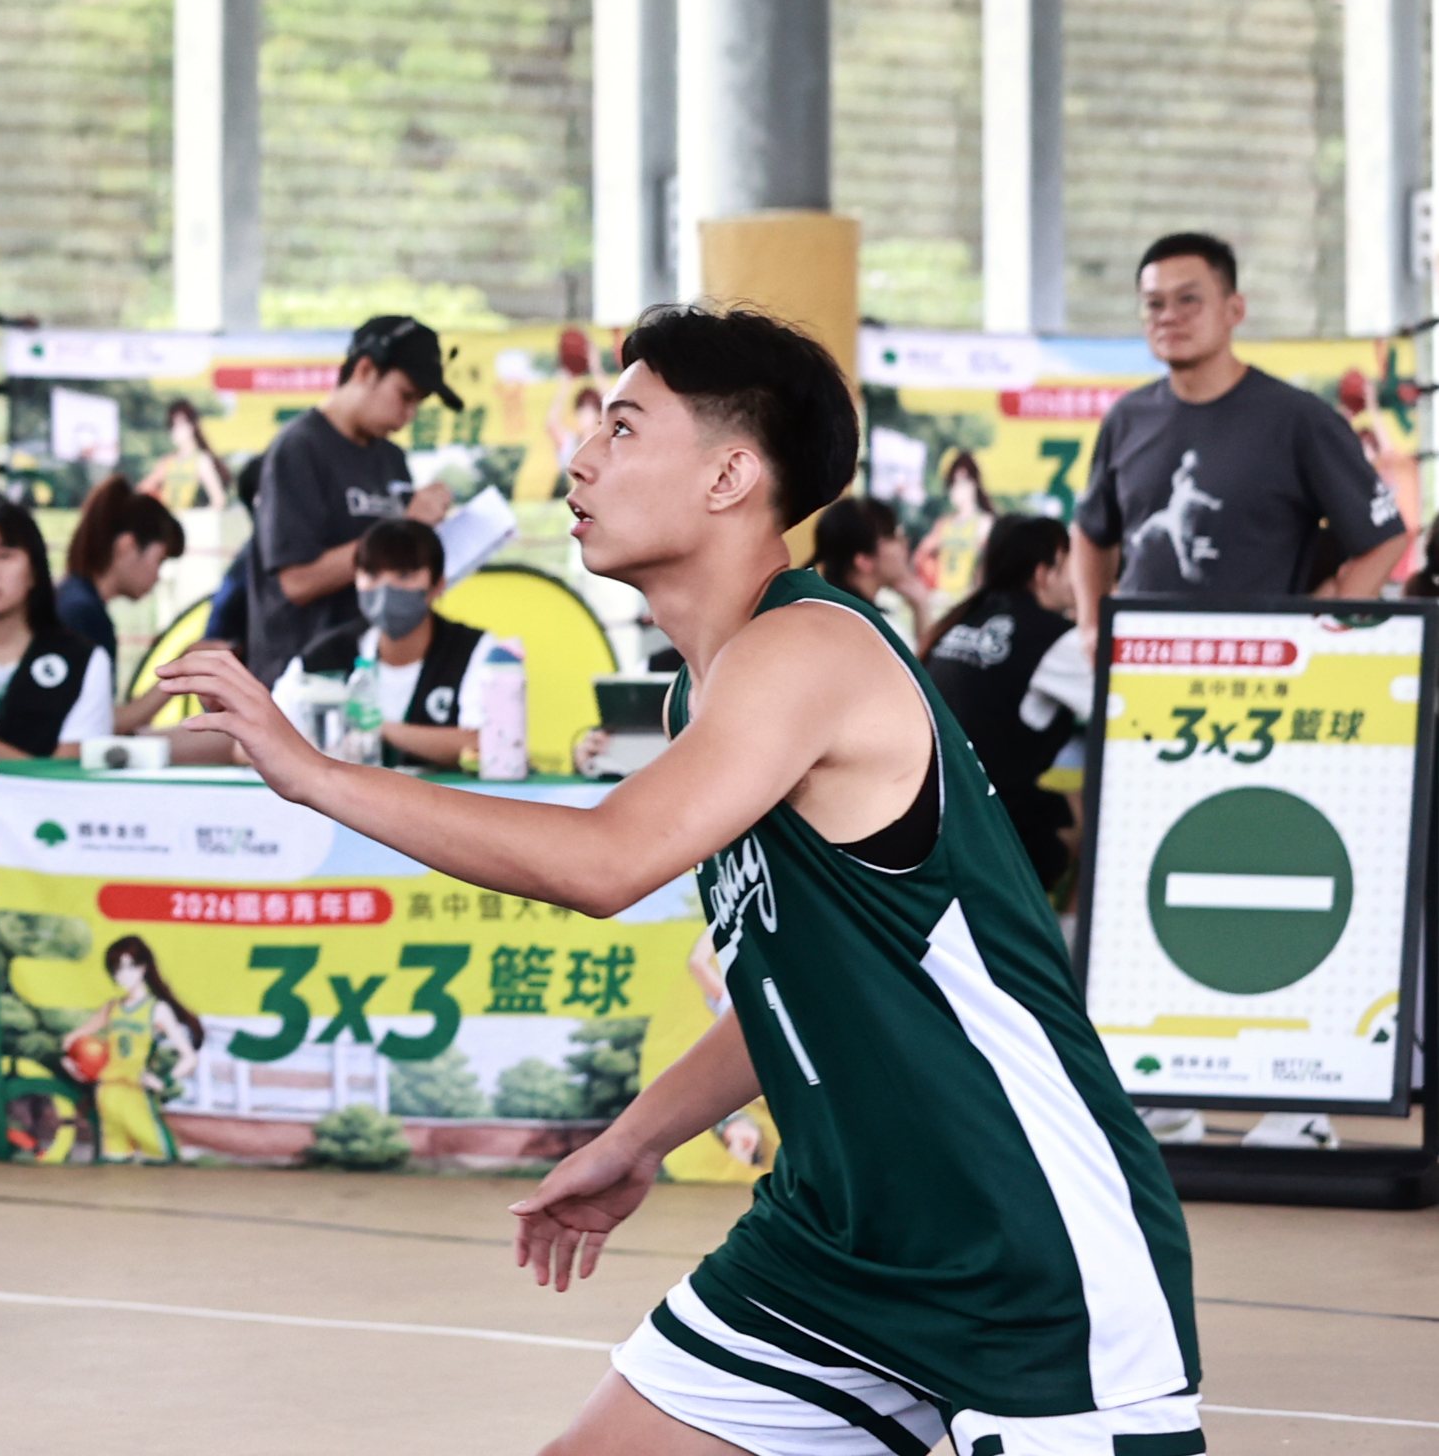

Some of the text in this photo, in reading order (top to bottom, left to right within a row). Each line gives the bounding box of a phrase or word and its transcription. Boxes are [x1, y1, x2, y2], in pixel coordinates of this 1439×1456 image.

[1157, 706, 1366, 764] 3x3 籃球
[170, 890, 376, 923] 2026國泰青年節
[228, 942, 636, 1062] 3x3 籃球
